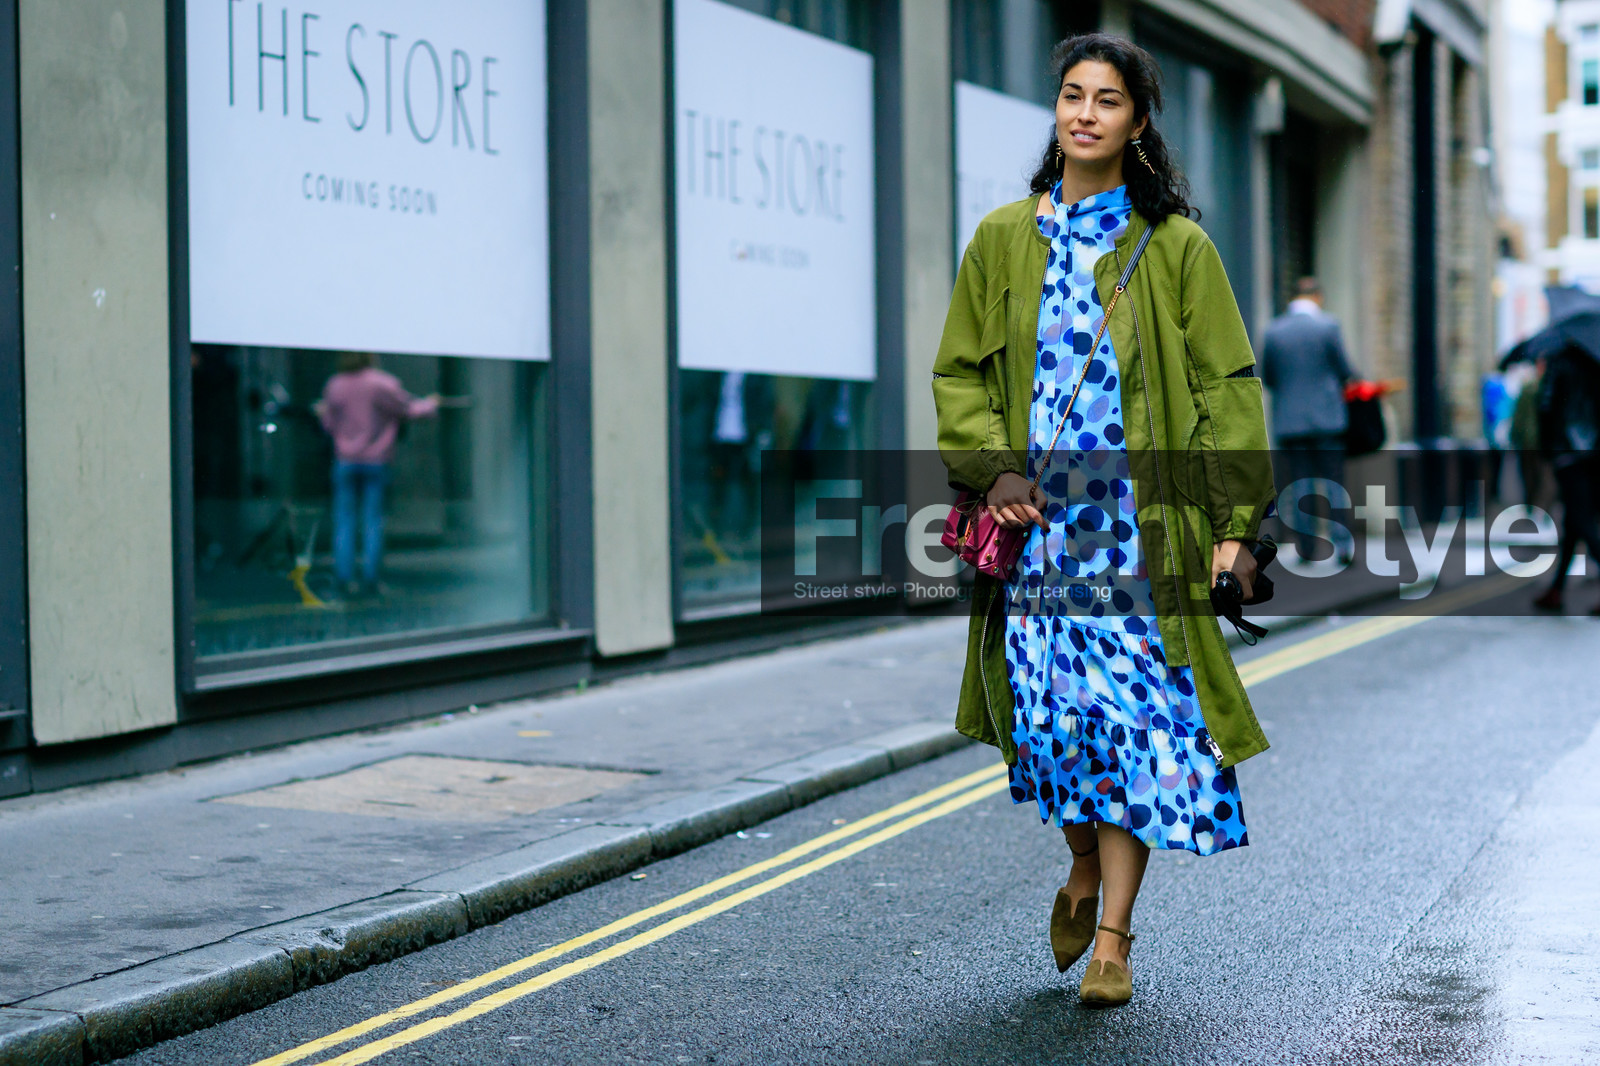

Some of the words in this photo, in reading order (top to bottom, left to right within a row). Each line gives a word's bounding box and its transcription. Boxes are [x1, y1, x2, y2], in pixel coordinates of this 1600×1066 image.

[227, 0, 322, 123] THE
[345, 22, 500, 156] STORE
[301, 172, 380, 209] COMING
[387, 184, 438, 216] SOON
[684, 109, 742, 206] THE
[751, 124, 846, 224] STORE
